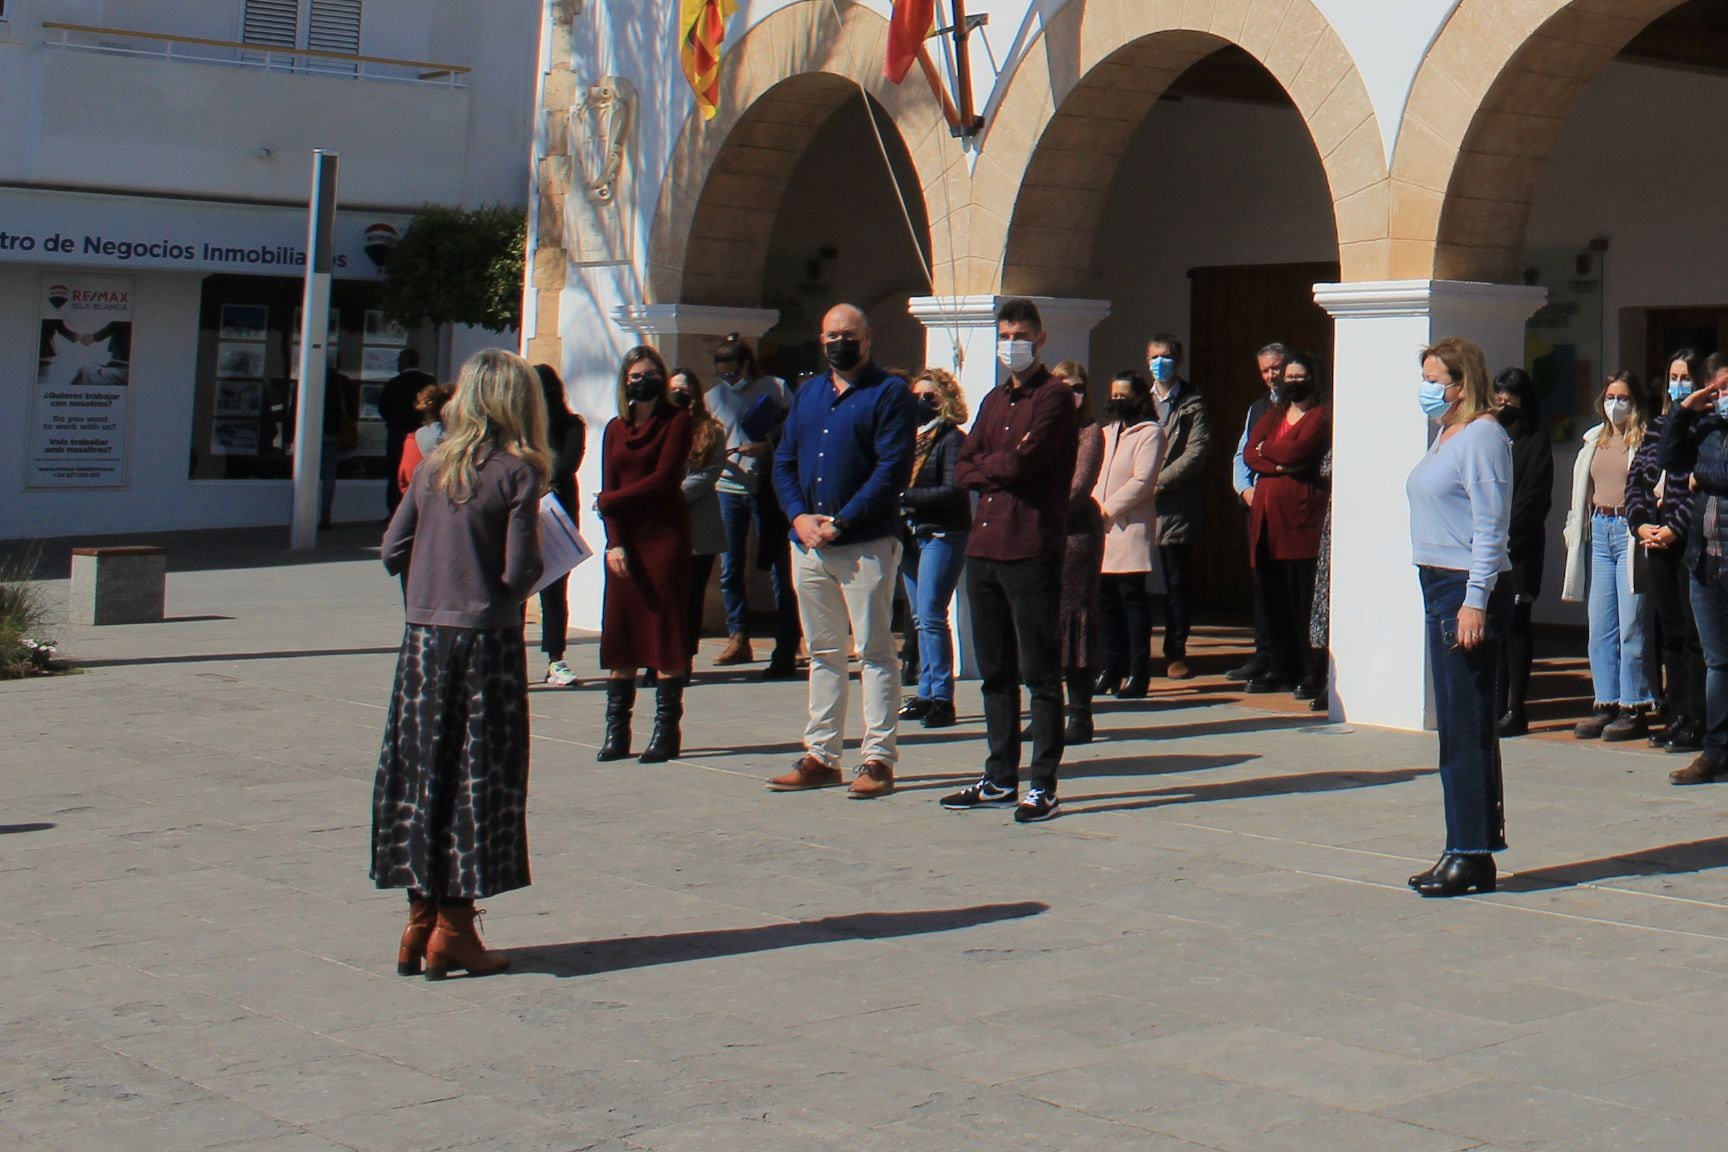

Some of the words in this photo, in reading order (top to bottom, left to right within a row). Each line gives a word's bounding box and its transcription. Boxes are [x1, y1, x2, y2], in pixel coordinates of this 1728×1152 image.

[0, 232, 35, 251] tro
[43, 233, 75, 253] de
[84, 236, 195, 260] Negocios
[203, 243, 348, 268] Inmobilias
[72, 290, 129, 303] RE/MAX
[85, 392, 120, 401] trabajar
[69, 400, 113, 408] nosotros?
